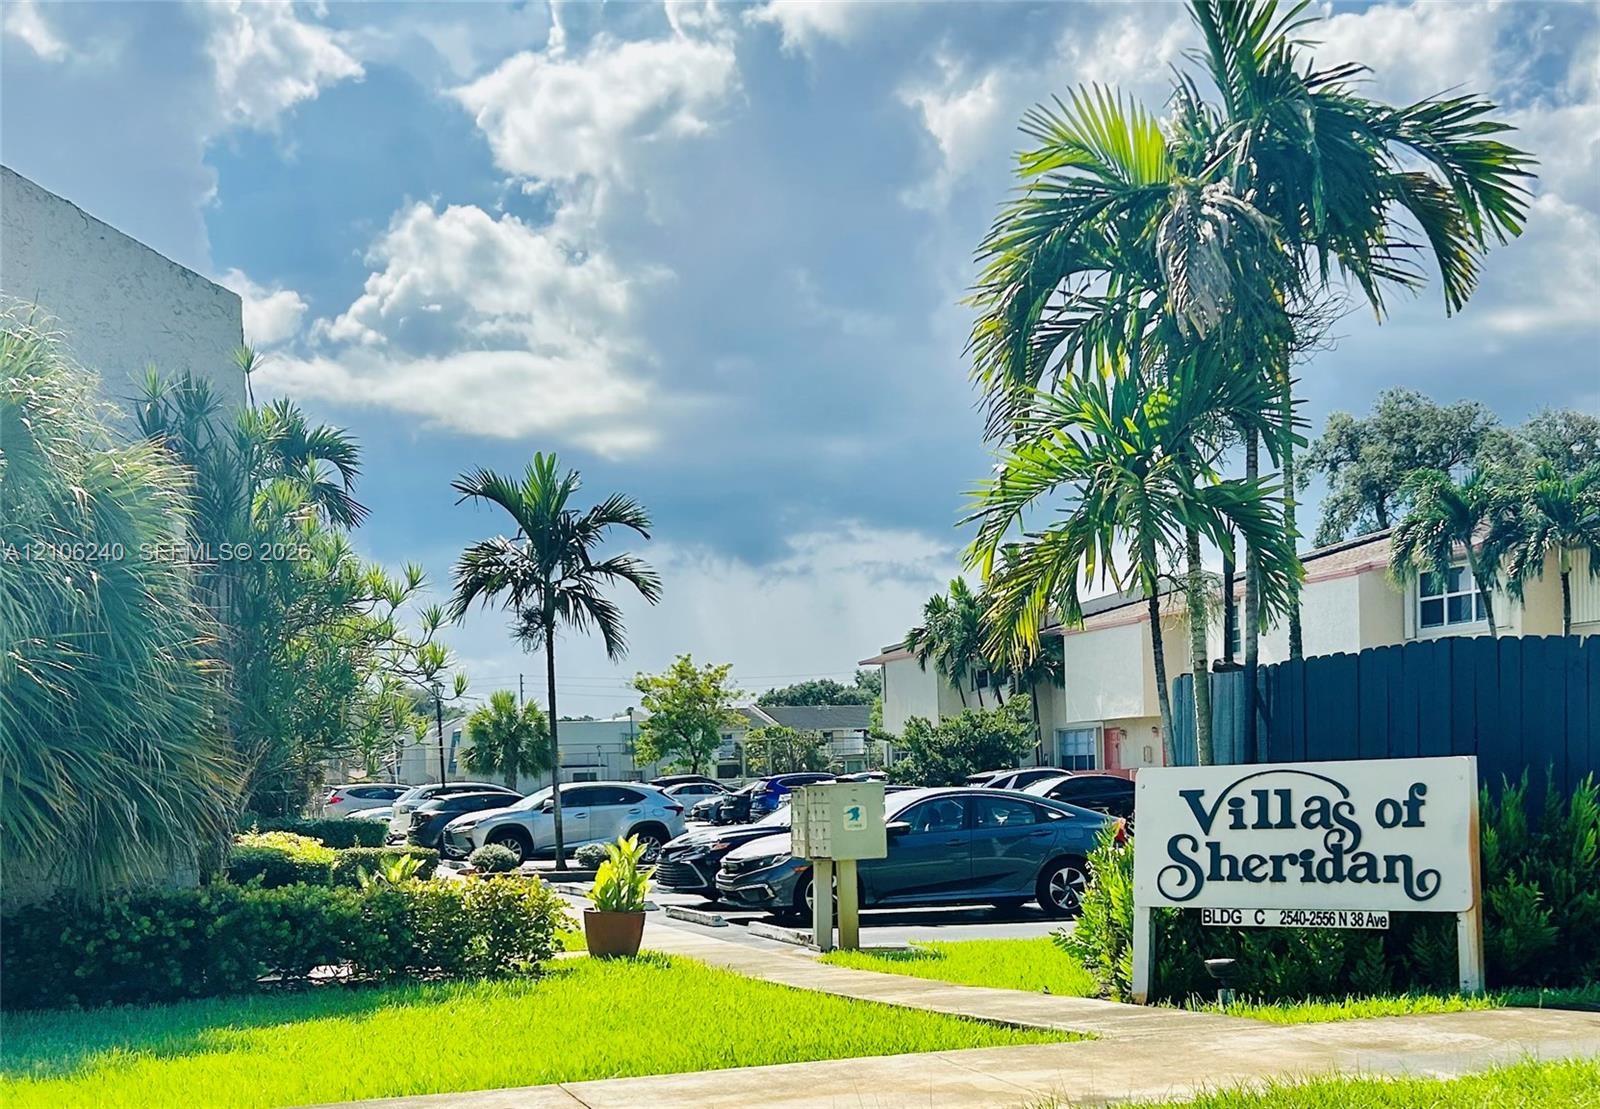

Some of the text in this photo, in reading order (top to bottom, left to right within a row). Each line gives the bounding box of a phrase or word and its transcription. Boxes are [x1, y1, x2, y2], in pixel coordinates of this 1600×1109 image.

[1179, 769, 1428, 855] Villas of
[1157, 833, 1441, 901] Sheridan
[1202, 909, 1387, 928] BLDG C 2540-2556 N 38 Ave
